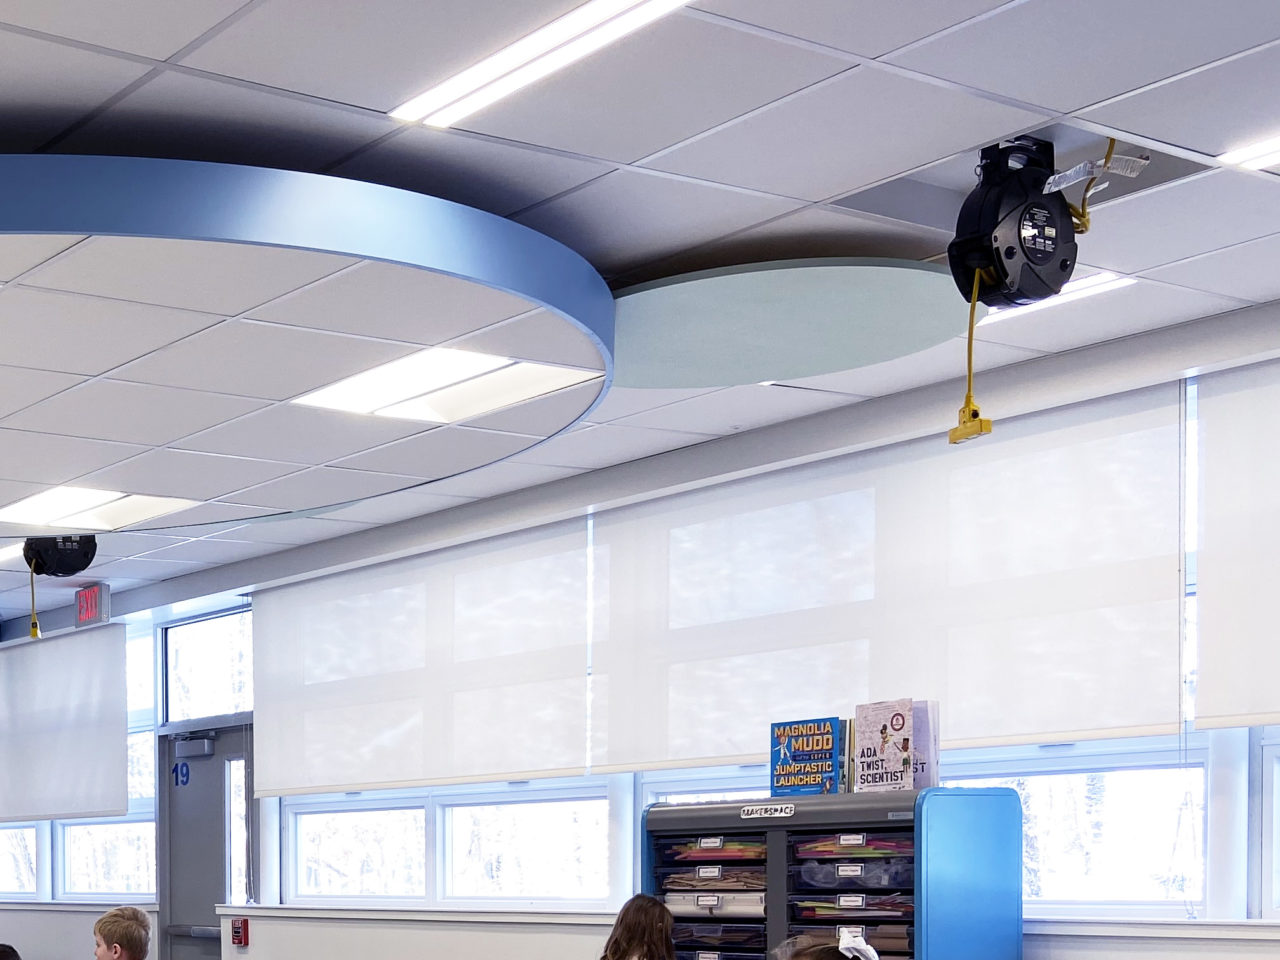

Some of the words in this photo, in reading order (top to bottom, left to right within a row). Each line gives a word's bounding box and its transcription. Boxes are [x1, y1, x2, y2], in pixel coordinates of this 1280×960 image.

[78, 585, 100, 622] EXIT
[774, 722, 833, 738] MAGNOLIA
[791, 735, 833, 752] MUDD
[860, 747, 877, 759] ADA
[172, 762, 189, 786] 19
[774, 761, 832, 775] JUMPTASTIC
[774, 774, 822, 787] LAUNCHER
[860, 770, 905, 785] SCIENTIST
[742, 806, 793, 817] MAKERSPACE
